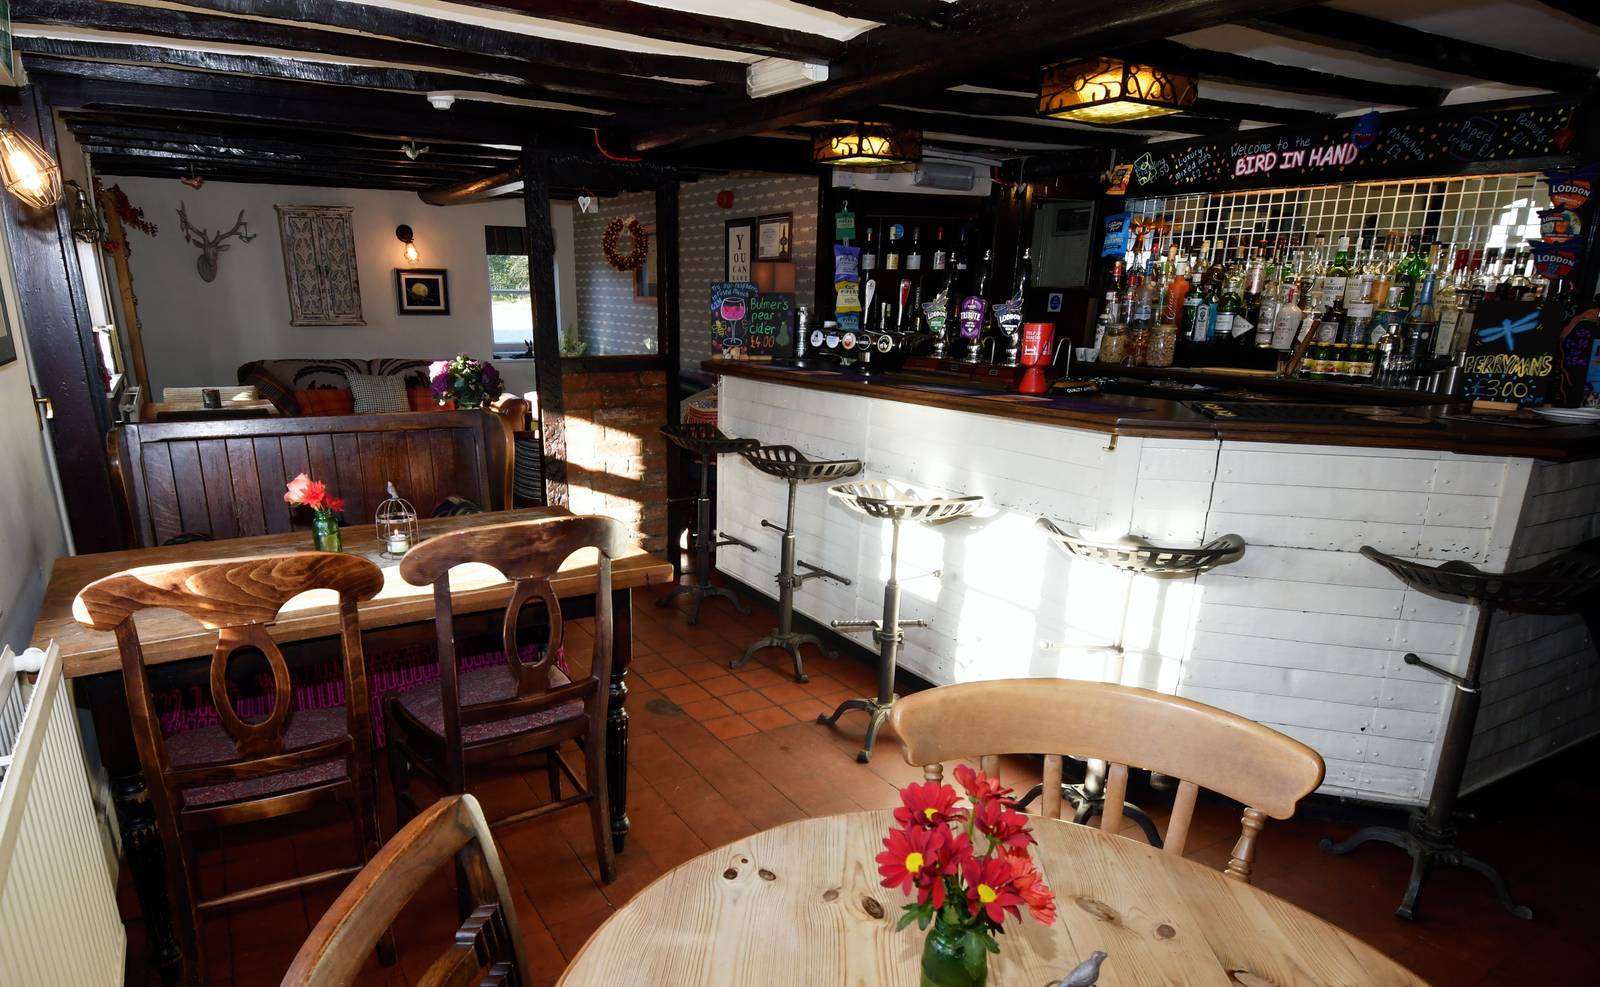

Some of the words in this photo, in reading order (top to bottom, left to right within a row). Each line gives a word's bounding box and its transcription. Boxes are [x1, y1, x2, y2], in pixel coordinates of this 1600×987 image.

[1231, 143, 1272, 157] Welcome
[1277, 139, 1289, 151] to
[1296, 136, 1311, 147] the
[1178, 147, 1204, 167] Luxury
[1235, 152, 1277, 176] BIRD
[1279, 150, 1306, 170] IN
[1308, 142, 1359, 167] HAND
[1174, 161, 1197, 181] mixed
[1552, 184, 1591, 198] LODDON
[1537, 254, 1576, 268] LODDON
[751, 312, 775, 323] pear
[960, 311, 981, 321] TRIBUTE
